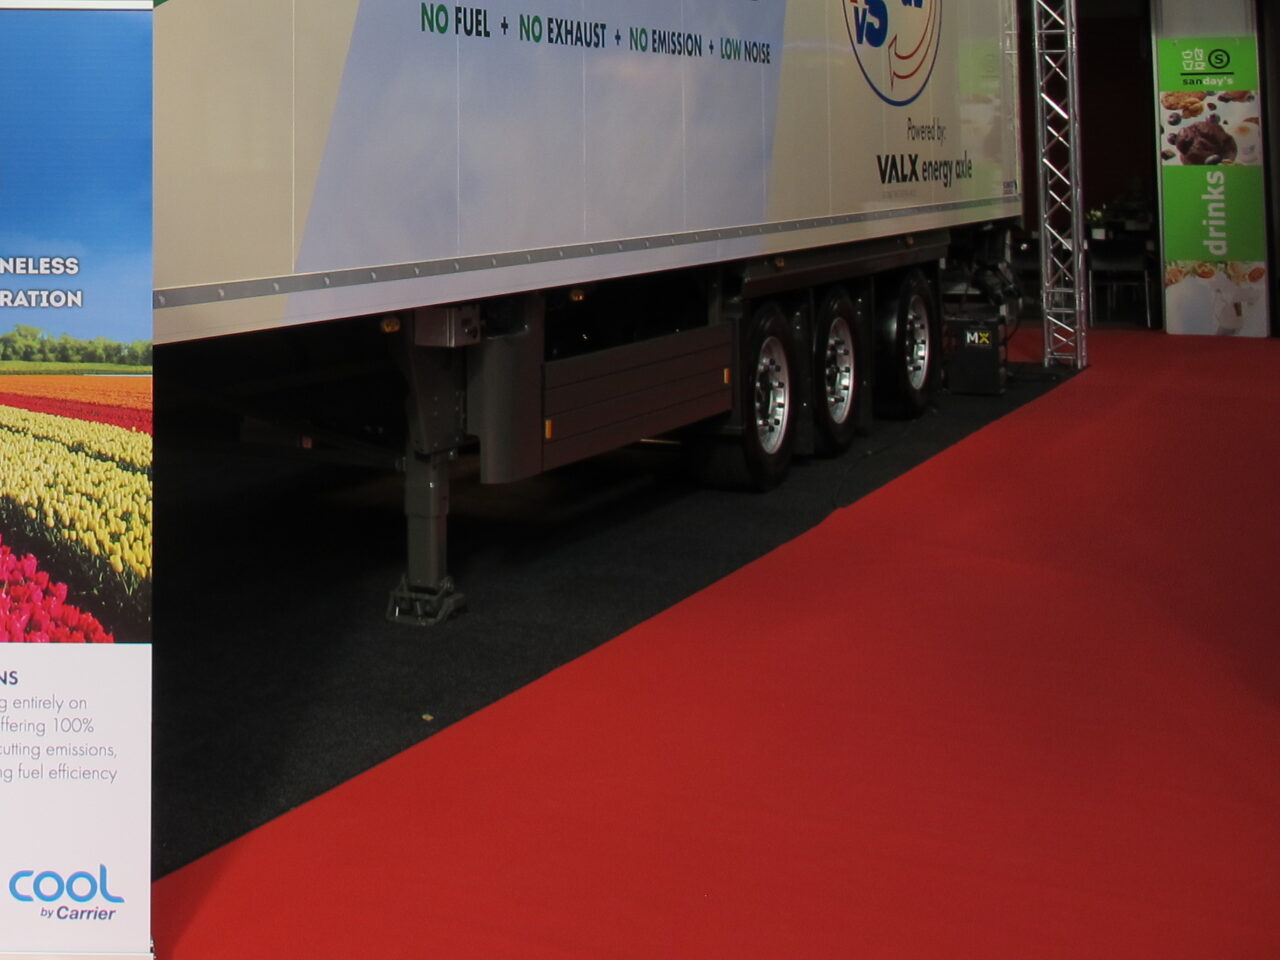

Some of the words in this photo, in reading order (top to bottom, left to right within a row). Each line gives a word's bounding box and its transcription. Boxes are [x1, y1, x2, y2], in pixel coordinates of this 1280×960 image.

[420, 2, 450, 34] NO
[455, 6, 491, 38] FUEL
[519, 13, 543, 43] NO
[547, 17, 607, 49] EXHAUST
[629, 26, 648, 53] NO
[651, 29, 703, 57] EMISSION
[720, 37, 742, 61] LOW
[744, 41, 771, 65] NOISE
[907, 116, 936, 141] Powered
[876, 153, 920, 185] VALX
[922, 159, 953, 188] energy
[955, 150, 973, 179] axle
[1201, 170, 1228, 257] drinks
[965, 330, 992, 345] MX
[12, 693, 64, 714] entirely
[68, 698, 88, 710] on
[53, 717, 95, 734] 100%
[45, 743, 118, 759] emissions,
[18, 762, 44, 779] fuel
[48, 763, 118, 784] efficiency
[8, 863, 126, 904] cool
[40, 906, 54, 921] by
[56, 904, 117, 921] Carrier
